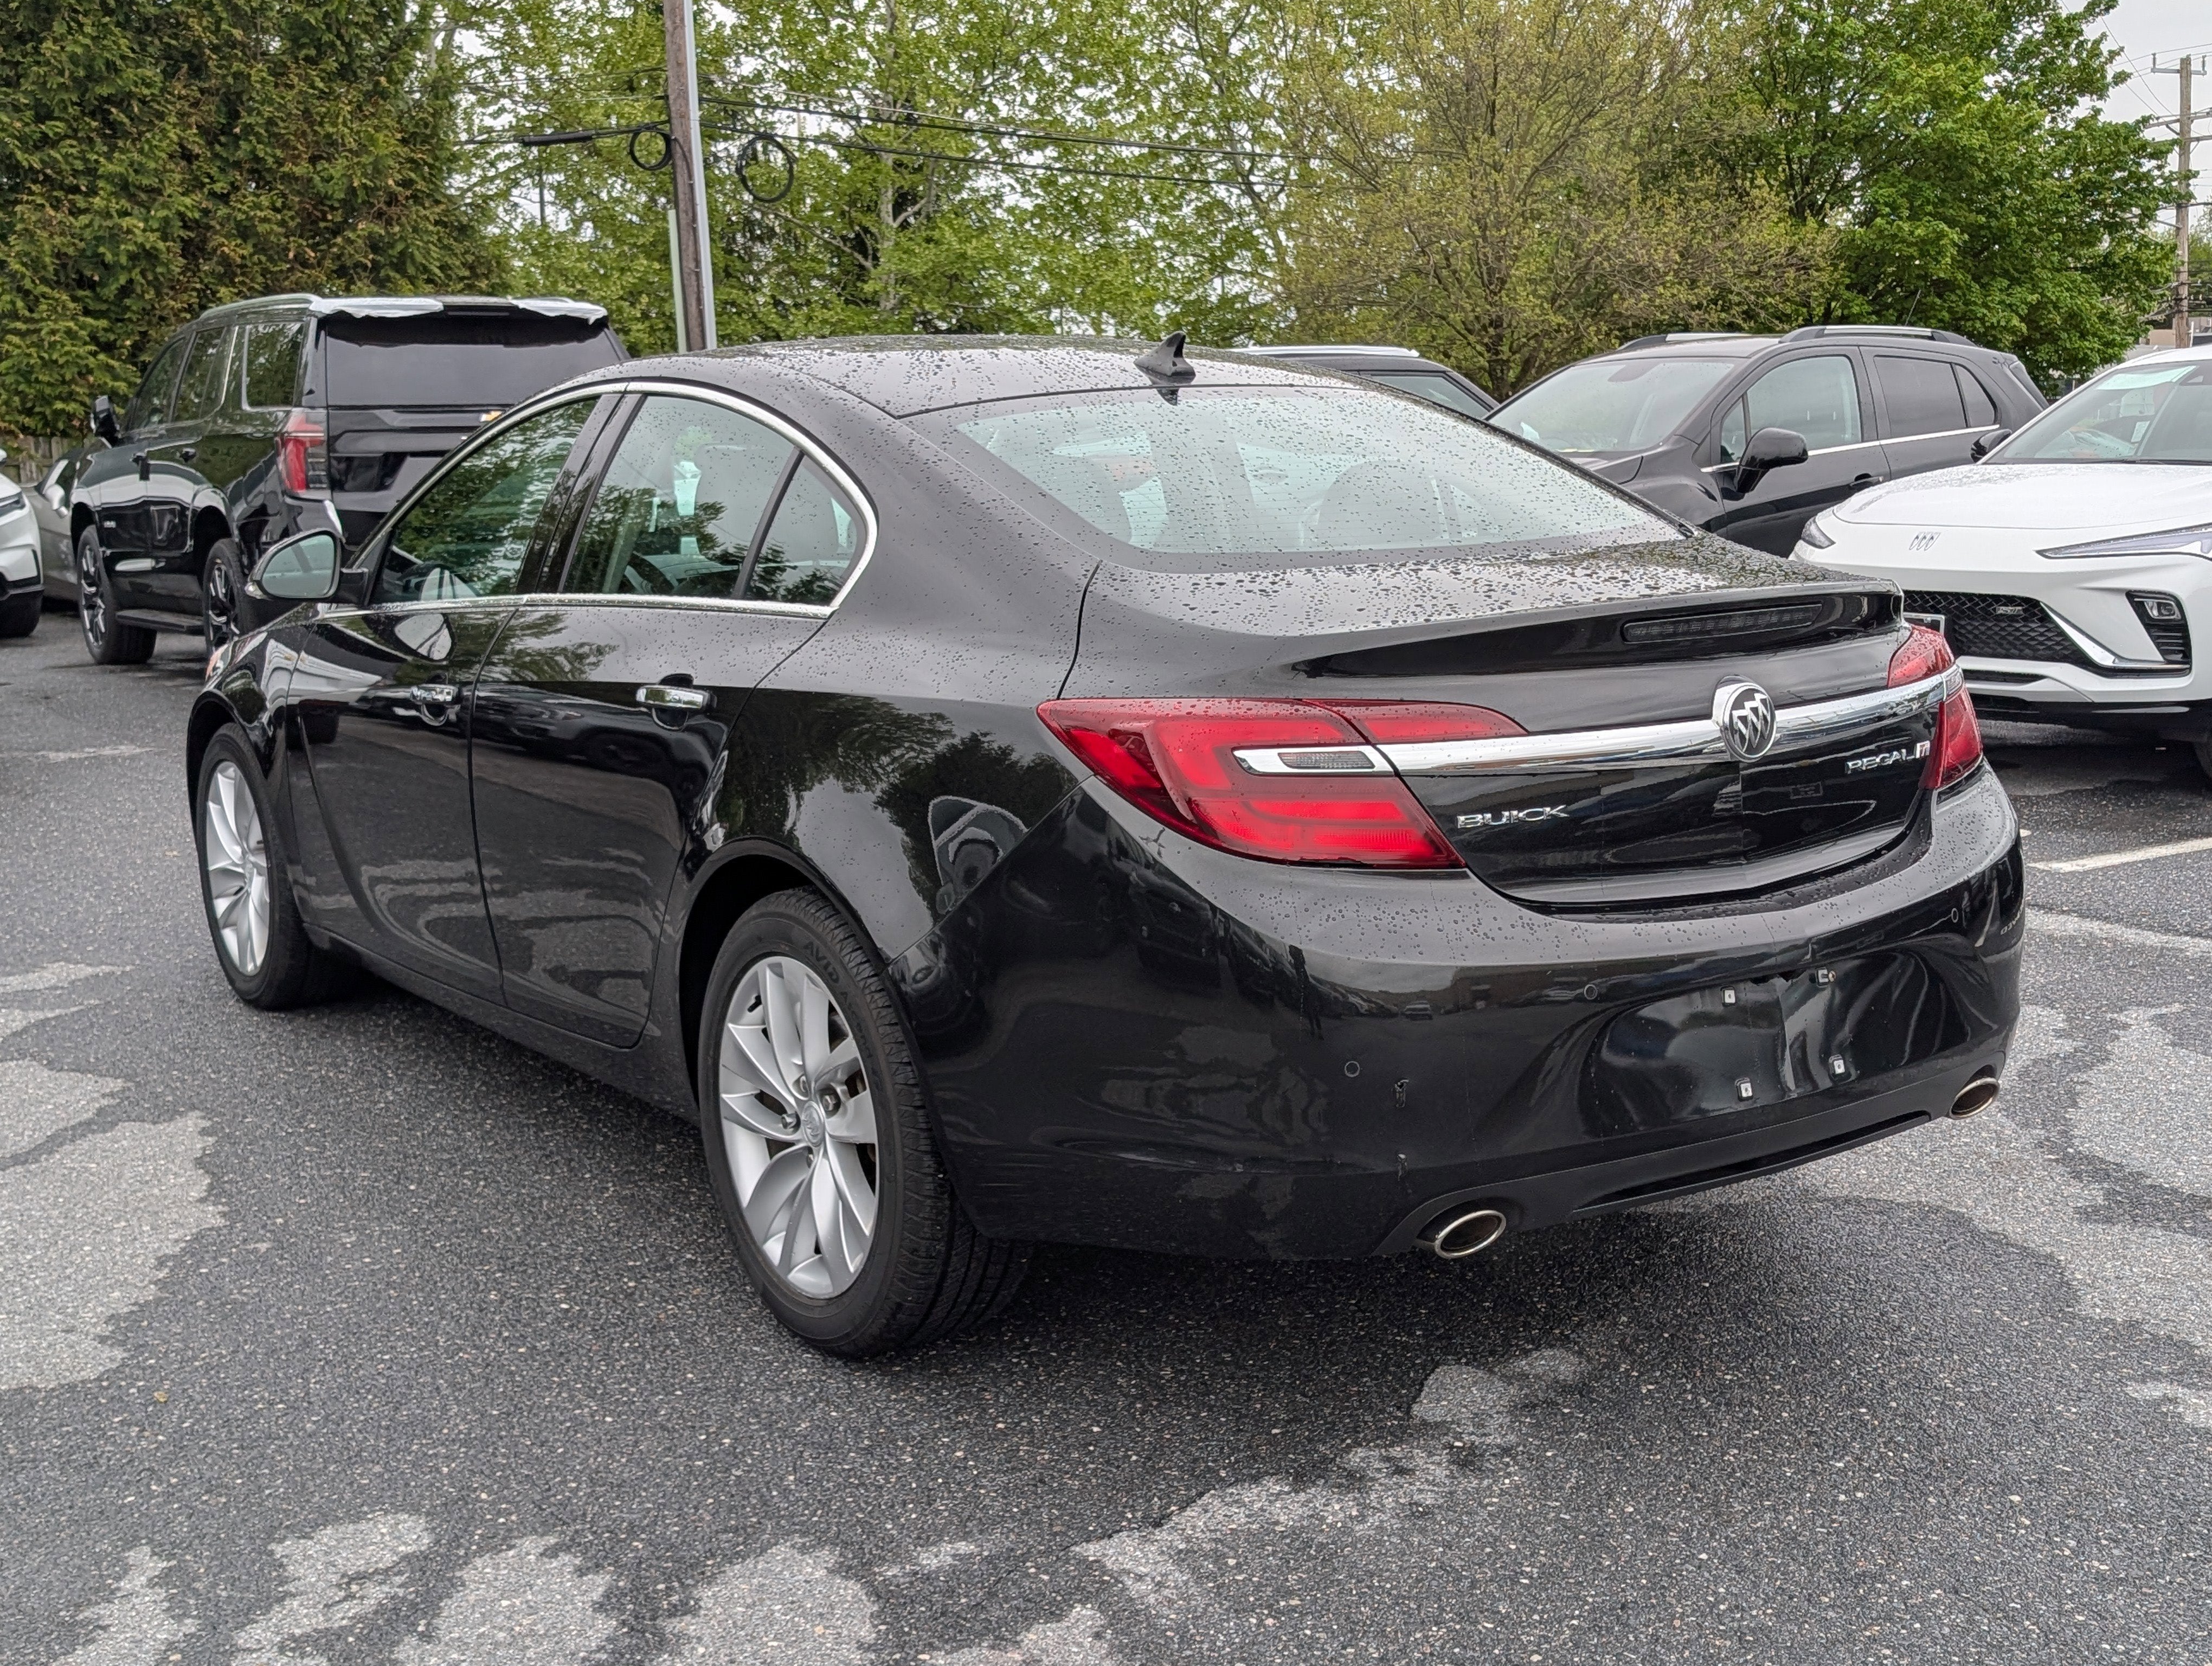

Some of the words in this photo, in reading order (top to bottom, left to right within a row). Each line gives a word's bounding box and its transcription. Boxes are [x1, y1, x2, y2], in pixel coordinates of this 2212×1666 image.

[1844, 748, 1915, 774] REGAL
[1456, 804, 1570, 829] BUICK
[803, 941, 840, 984] AVID
